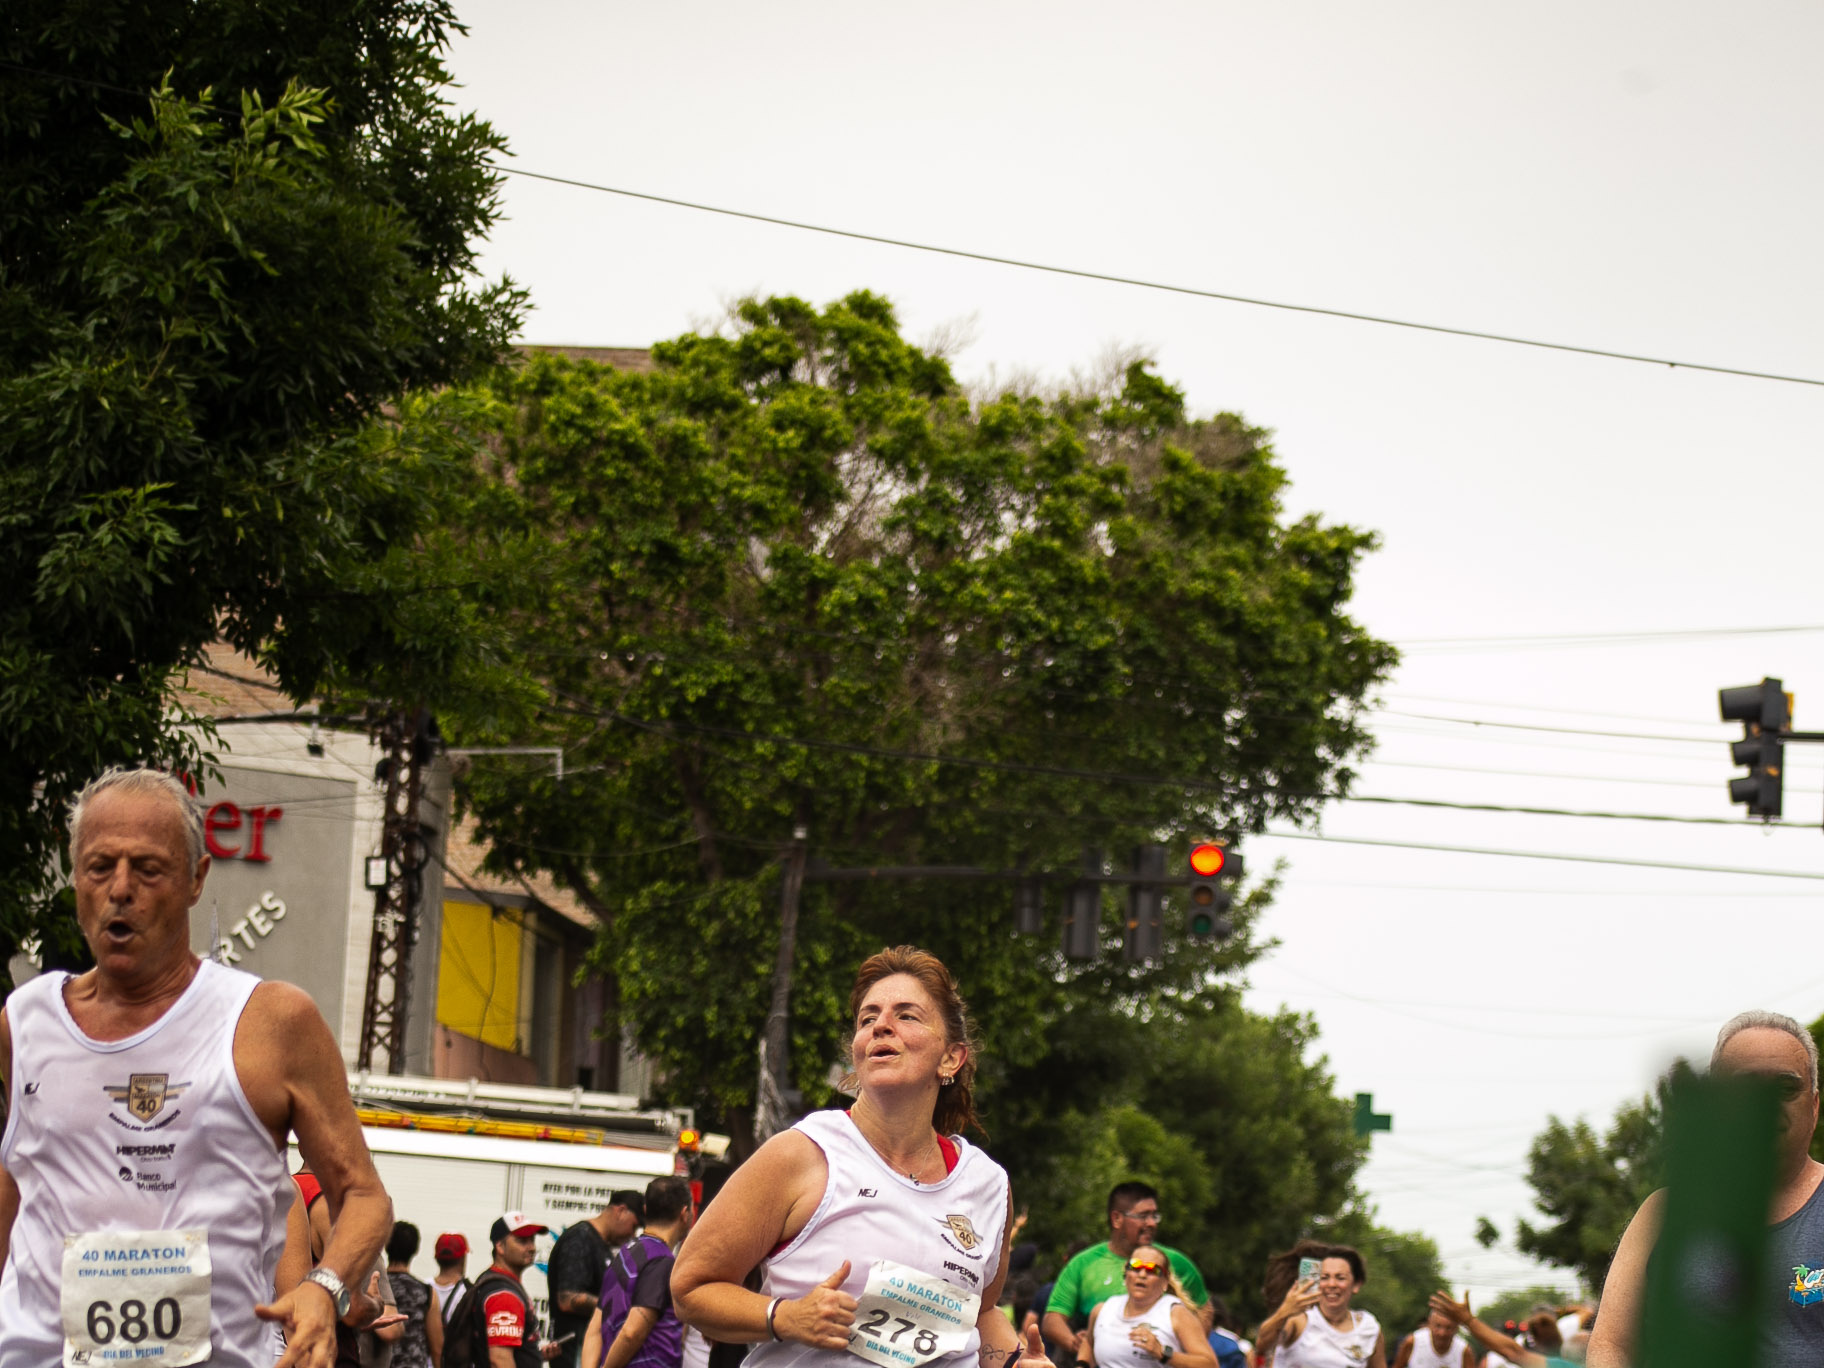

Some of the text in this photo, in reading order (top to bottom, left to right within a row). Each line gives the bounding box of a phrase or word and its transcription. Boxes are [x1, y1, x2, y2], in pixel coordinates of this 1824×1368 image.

[190, 785, 284, 862] er
[199, 891, 287, 967] RTES
[136, 1180, 177, 1192] Municipal
[78, 1265, 192, 1278] EMPALME GRANEROS
[82, 1247, 186, 1261] 40 MARATON
[881, 1288, 919, 1309] EMPALME
[920, 1304, 962, 1325] GRANEROS
[889, 1276, 904, 1289] 40
[907, 1282, 963, 1313] MARATON
[86, 1297, 182, 1345] 680
[857, 1309, 940, 1356] 278
[135, 1346, 164, 1357] VECINO
[879, 1345, 891, 1356] DEL
[891, 1351, 917, 1365] VECINO
